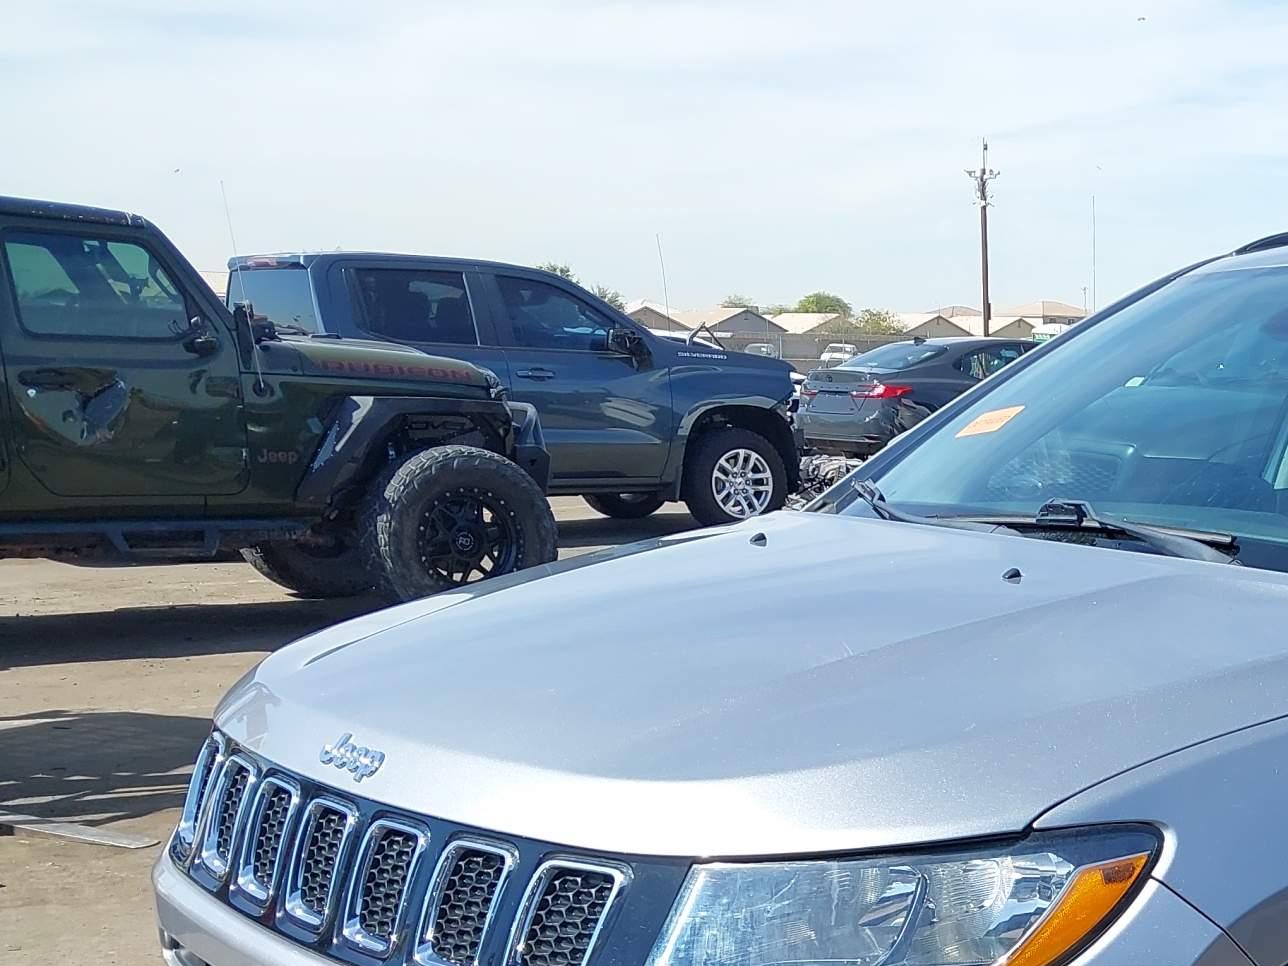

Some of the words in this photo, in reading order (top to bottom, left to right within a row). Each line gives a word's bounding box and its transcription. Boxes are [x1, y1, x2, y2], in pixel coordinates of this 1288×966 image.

[322, 360, 472, 381] RUBICON
[257, 449, 299, 465] Jeep
[319, 733, 386, 783] Jeep
